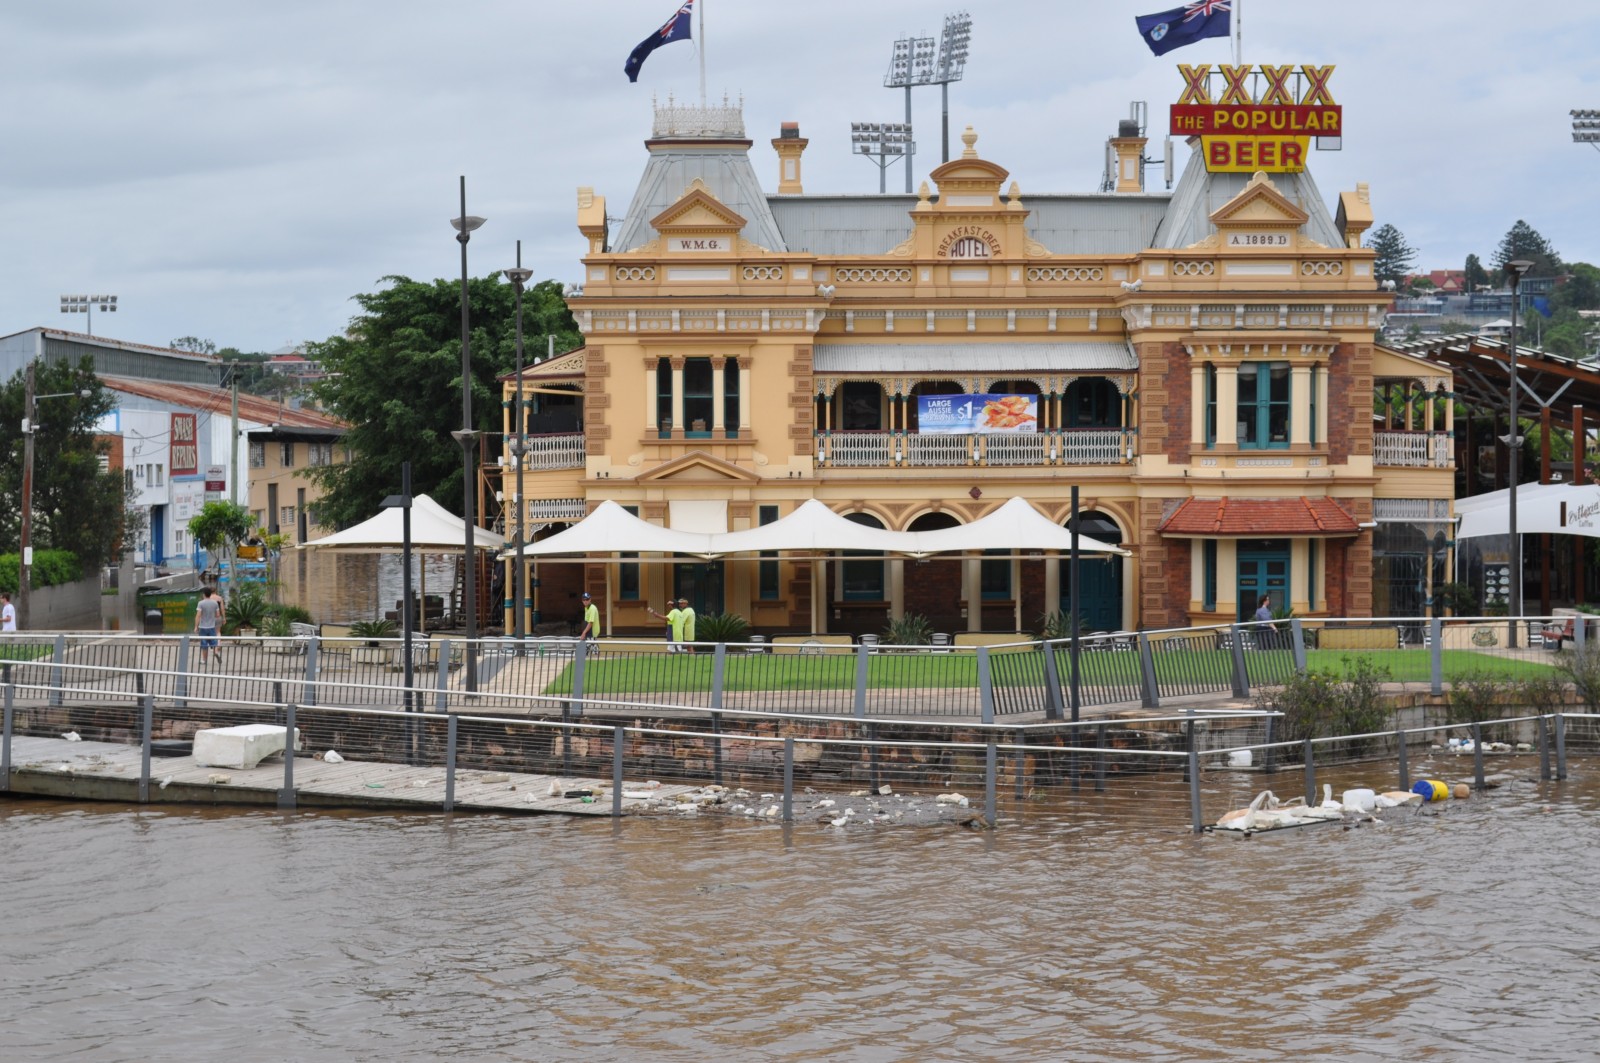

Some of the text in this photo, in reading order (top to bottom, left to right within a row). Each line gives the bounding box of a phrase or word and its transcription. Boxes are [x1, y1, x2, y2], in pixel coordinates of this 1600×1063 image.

[1176, 64, 1336, 105] XXXX
[1175, 110, 1339, 131] THE POPULAR
[1209, 141, 1303, 167] BEER
[937, 226, 1002, 257] BREAKFAST CREEK
[951, 237, 988, 257] HOTEL
[957, 401, 973, 421] $1
[174, 417, 193, 440] SMASH
[172, 445, 196, 469] REPAIRS
